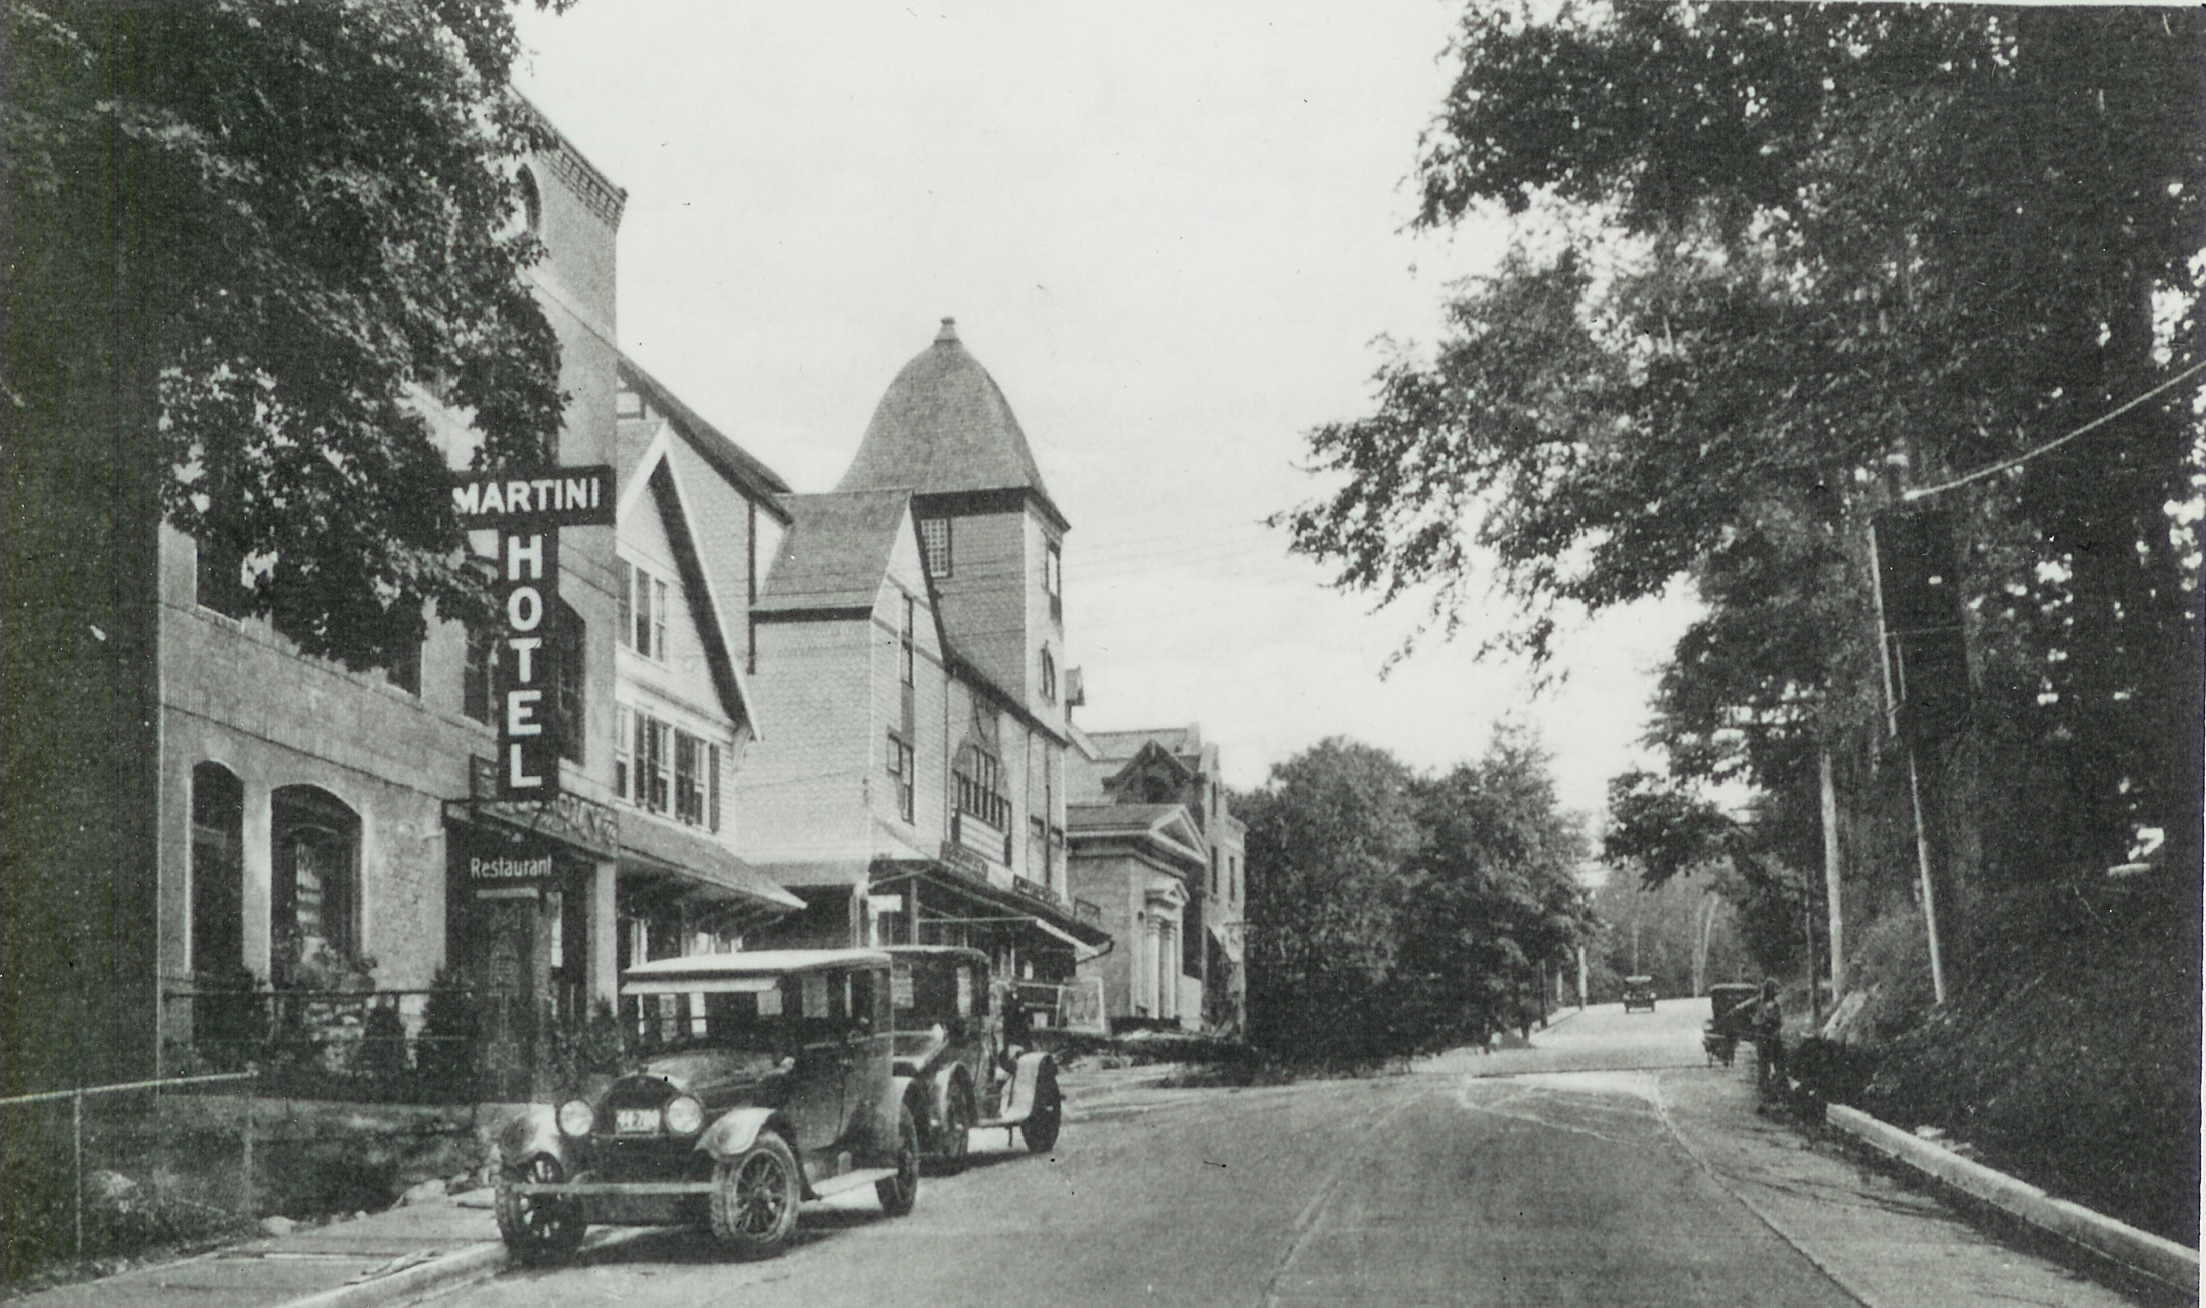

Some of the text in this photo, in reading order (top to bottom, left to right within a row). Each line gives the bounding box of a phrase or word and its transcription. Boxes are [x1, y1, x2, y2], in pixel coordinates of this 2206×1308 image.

[452, 477, 599, 515] MARTINI
[507, 533, 543, 788] HOTEL
[470, 854, 552, 878] Restaurant
